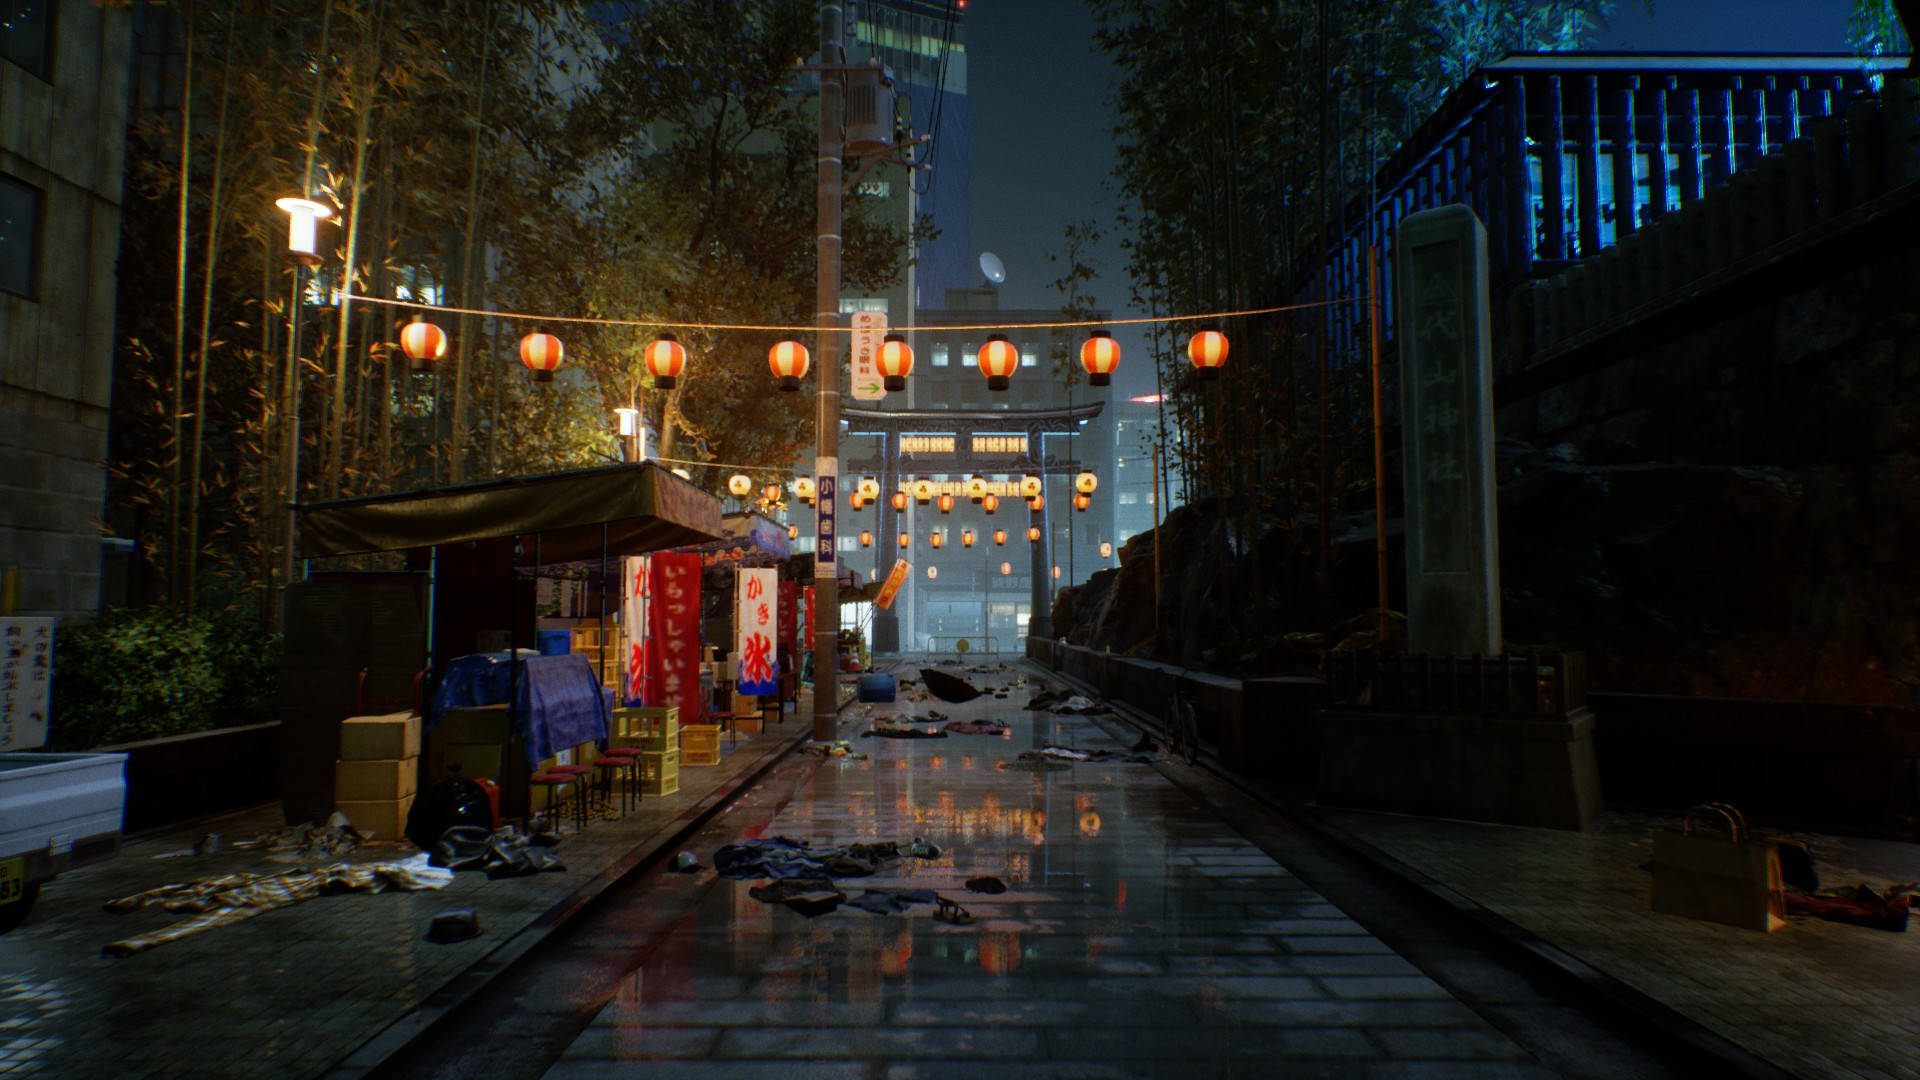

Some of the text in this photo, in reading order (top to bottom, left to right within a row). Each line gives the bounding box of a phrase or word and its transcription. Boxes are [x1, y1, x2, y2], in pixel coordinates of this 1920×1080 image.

[663, 565, 686, 706] いらっしゃいませ
[744, 575, 773, 684] かき氷
